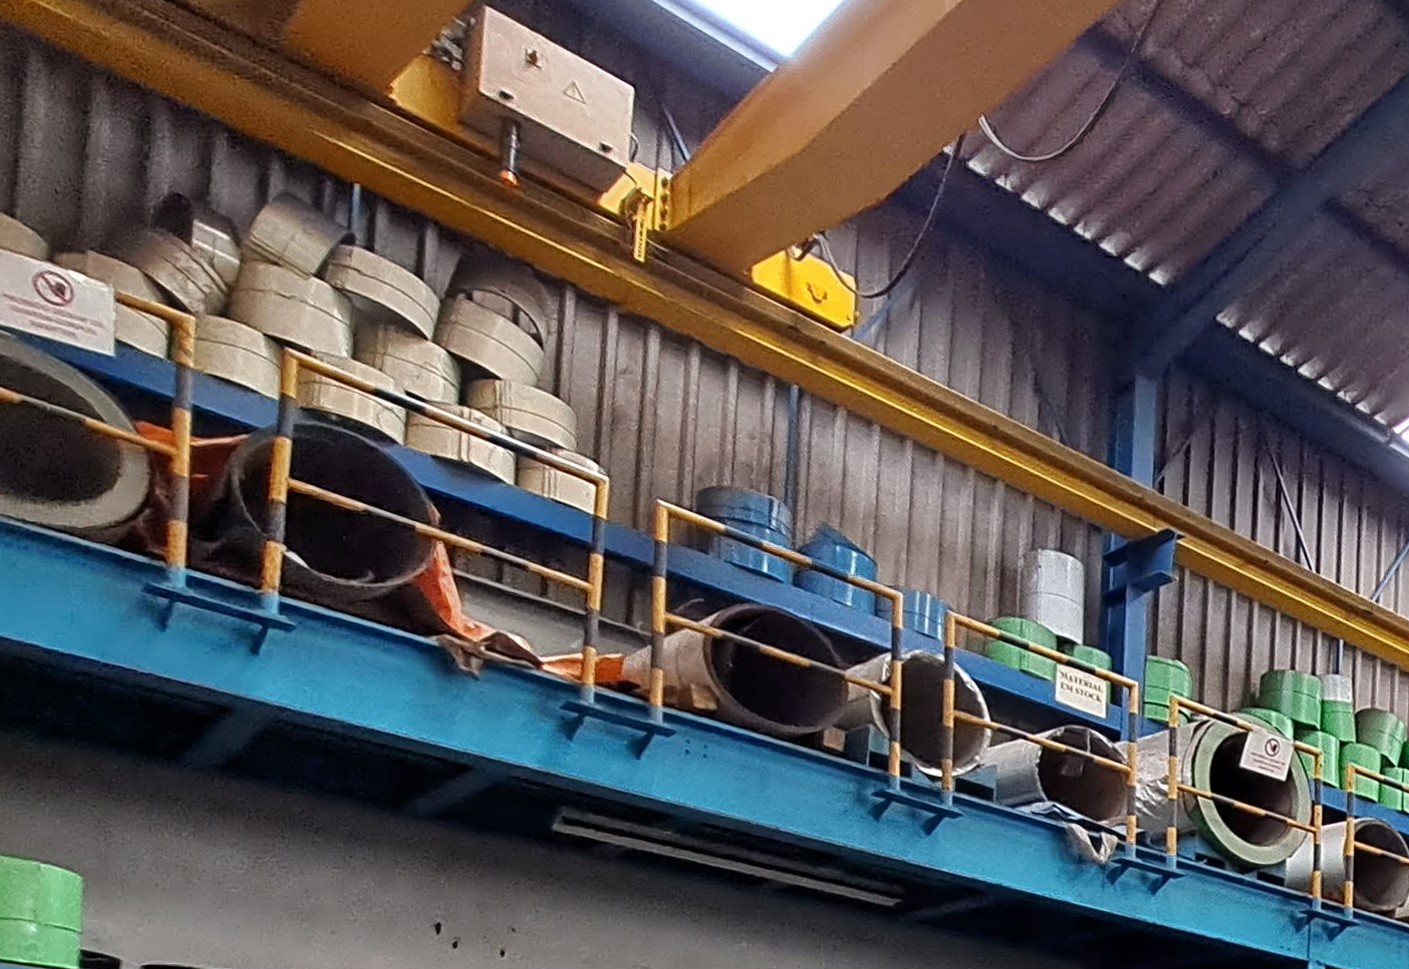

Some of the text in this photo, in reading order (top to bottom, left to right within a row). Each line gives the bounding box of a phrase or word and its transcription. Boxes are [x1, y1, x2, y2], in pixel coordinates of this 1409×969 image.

[1059, 670, 1103, 693] MATERIAL
[1060, 681, 1102, 703] EM STOCK
